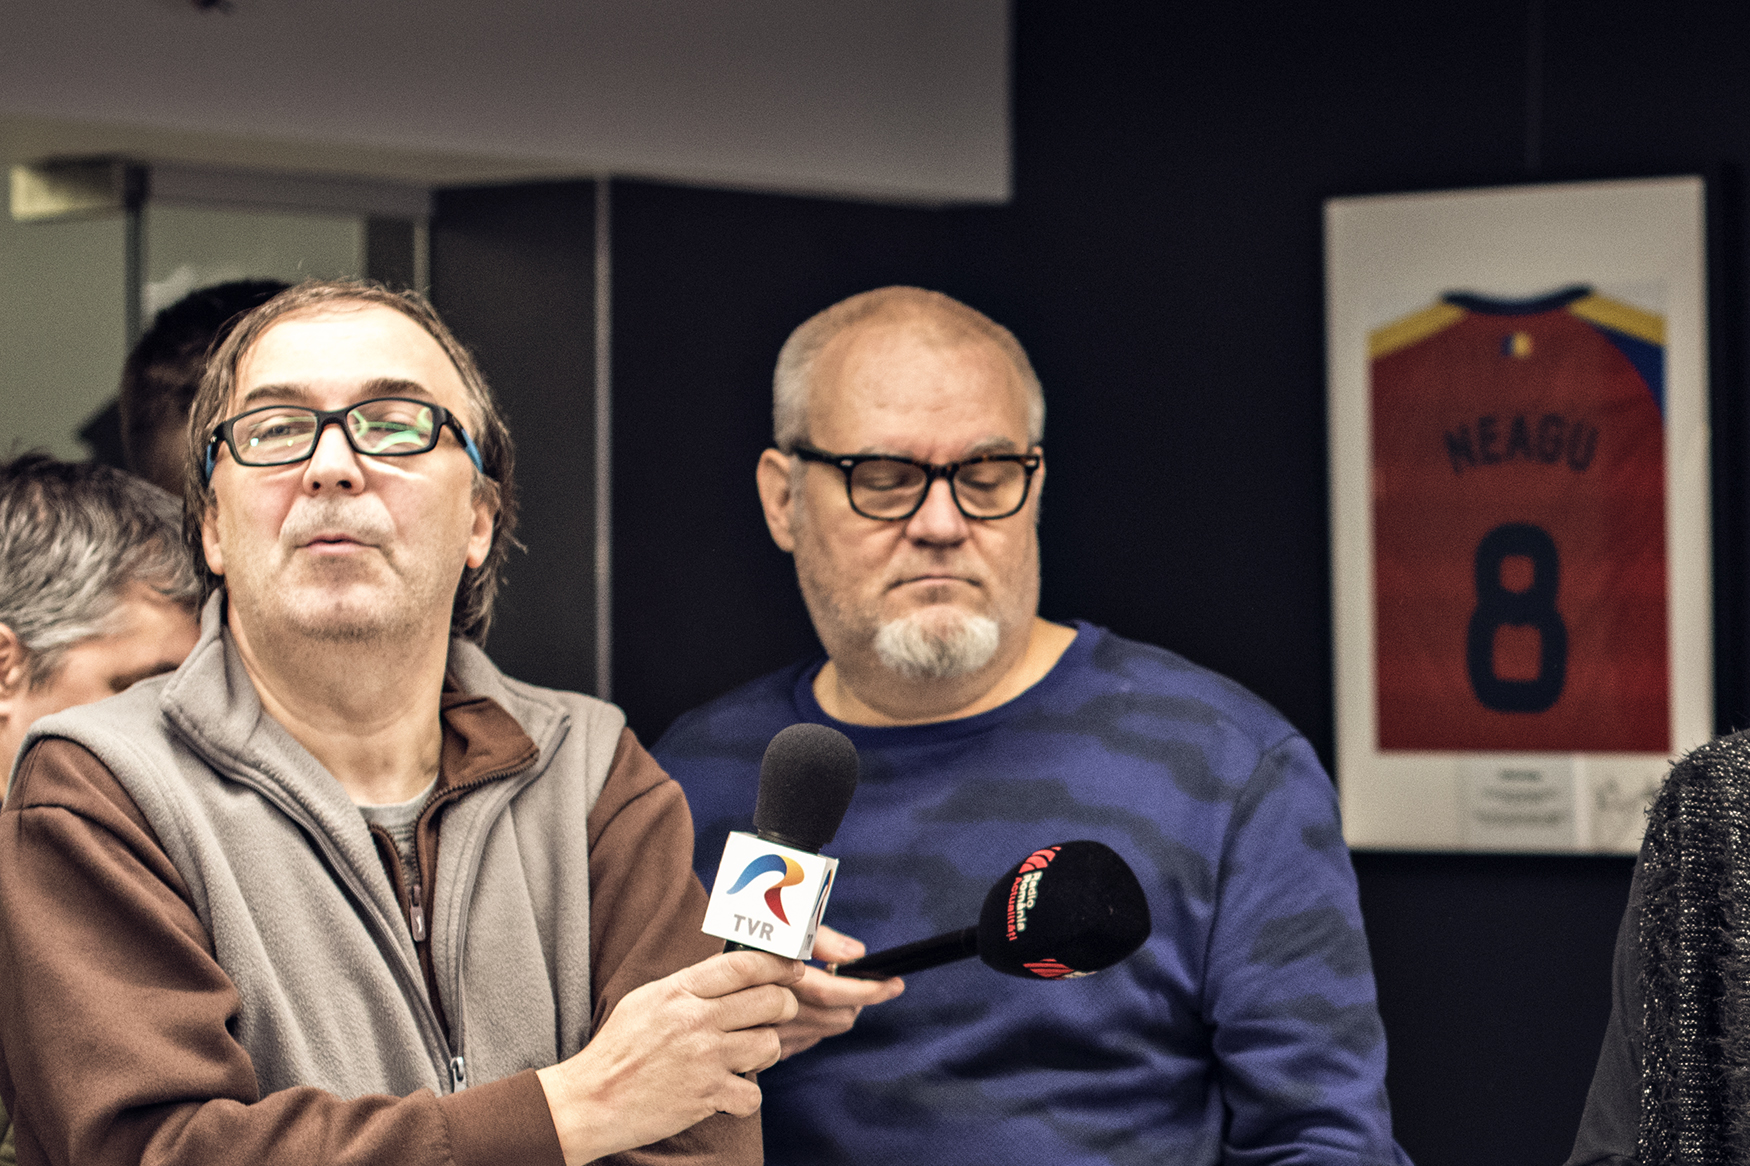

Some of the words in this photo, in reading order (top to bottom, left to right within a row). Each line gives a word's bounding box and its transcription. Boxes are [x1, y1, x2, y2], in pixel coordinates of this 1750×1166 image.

[1444, 411, 1600, 475] NEAGU
[1466, 522, 1569, 714] 8
[1026, 870, 1043, 909] Radio
[733, 913, 774, 942] TVR
